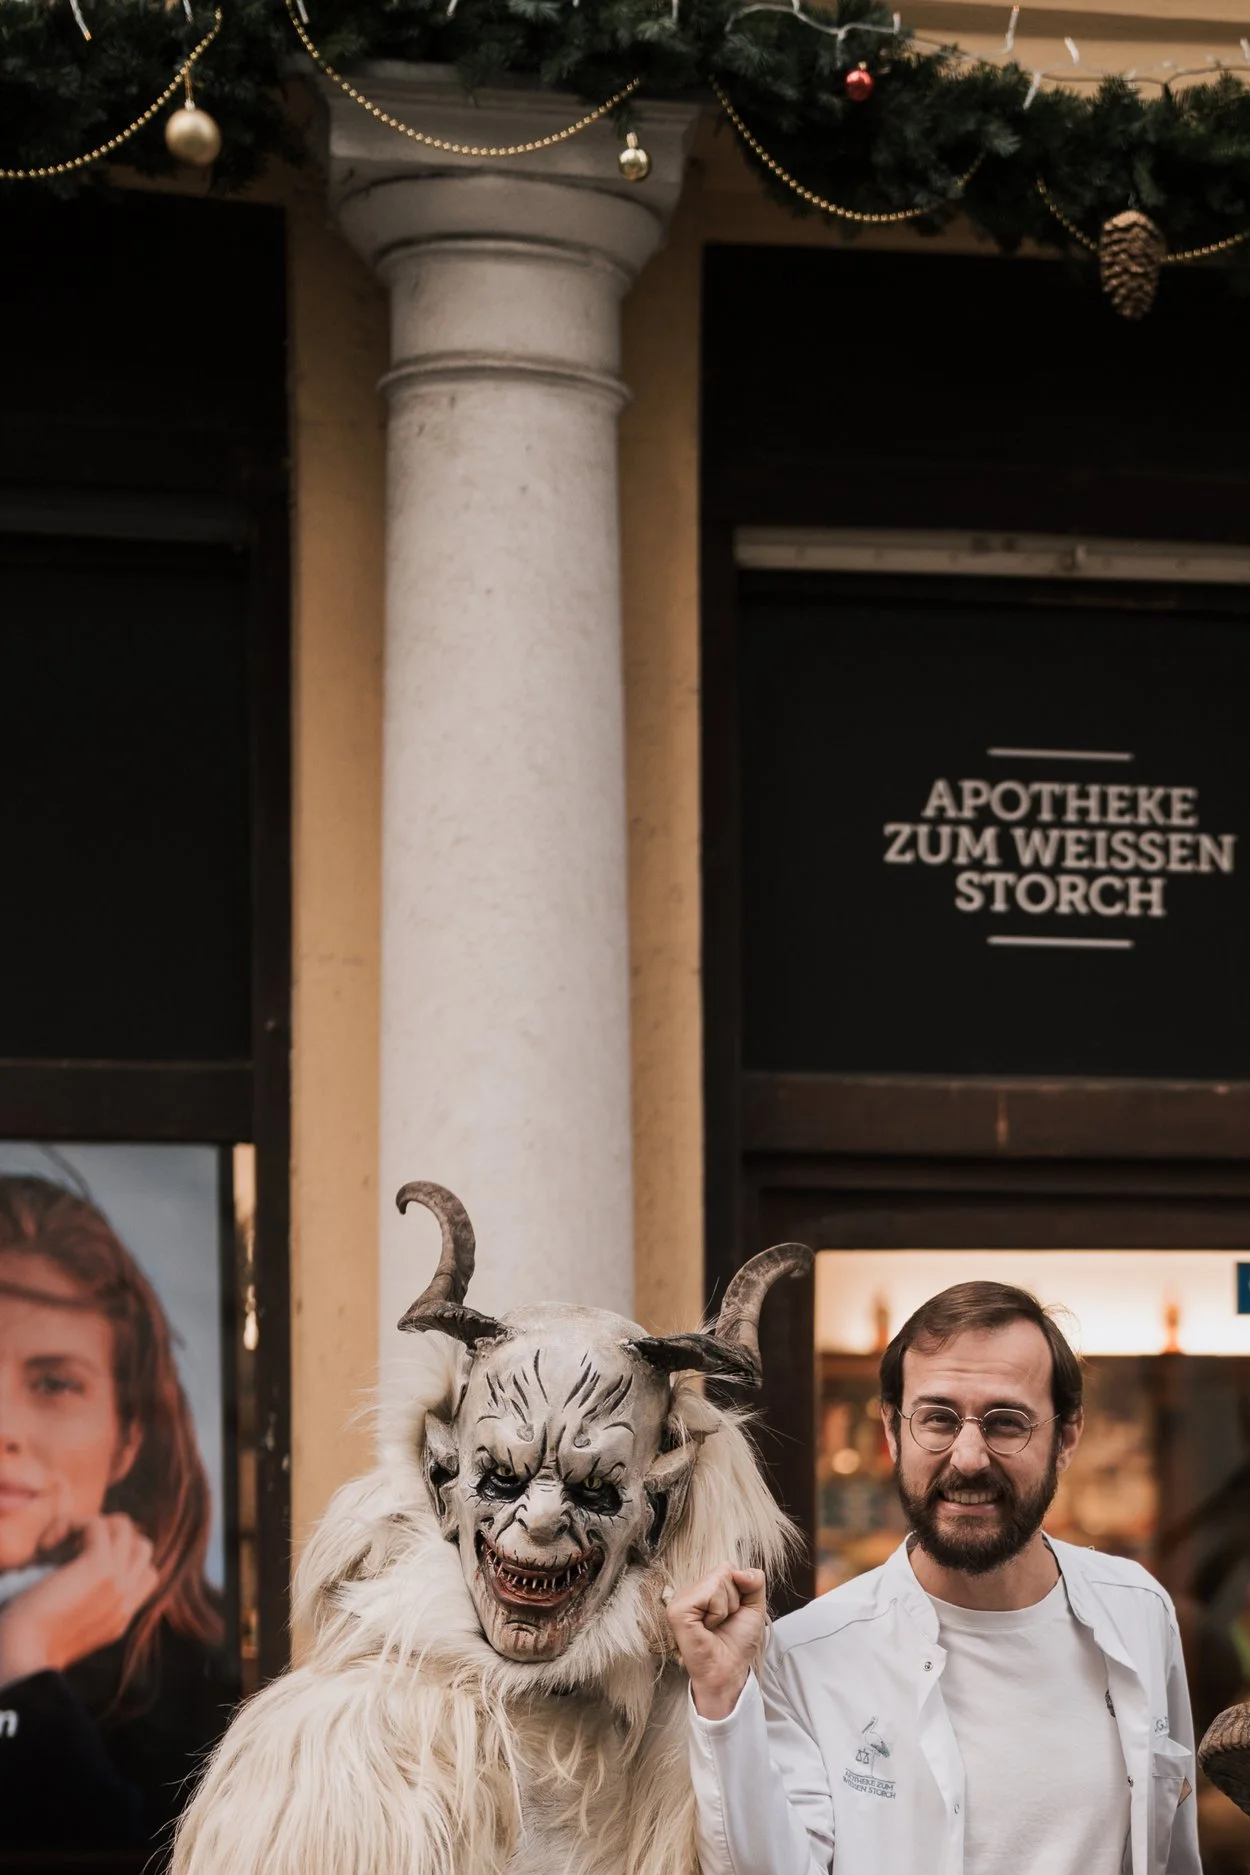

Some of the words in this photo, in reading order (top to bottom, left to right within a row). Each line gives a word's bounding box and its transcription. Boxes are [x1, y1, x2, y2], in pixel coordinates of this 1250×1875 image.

[921, 778, 1199, 827] APOTHEKE
[883, 823, 1002, 866] ZUM
[1010, 827, 1237, 873] WEISSEN
[954, 871, 1167, 917] STORCH
[867, 1786, 896, 1800] STORCH
[876, 1781, 894, 1792] ZUM
